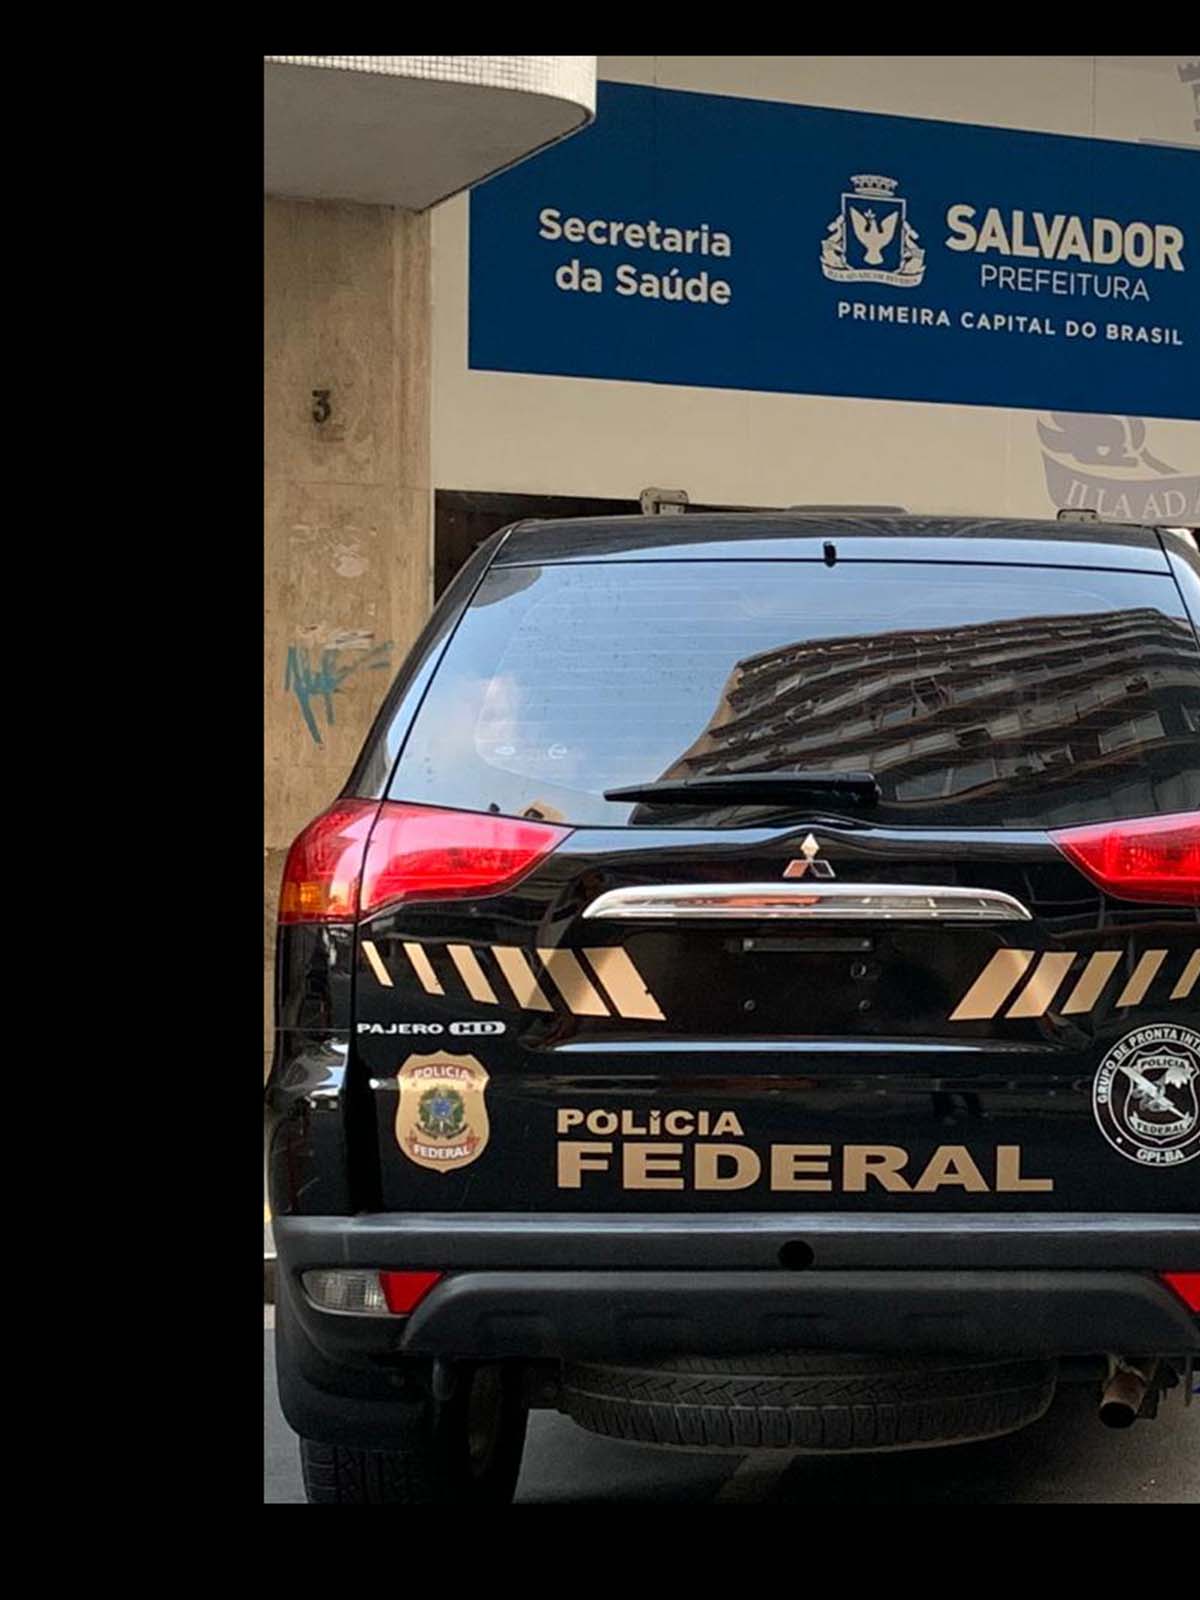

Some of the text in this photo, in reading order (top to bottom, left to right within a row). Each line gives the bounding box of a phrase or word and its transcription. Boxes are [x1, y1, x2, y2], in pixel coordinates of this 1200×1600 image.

[539, 208, 731, 257] Secretaria
[945, 204, 1185, 272] SALVADOR
[555, 249, 731, 304] da Saúde
[981, 264, 1151, 302] PREFEITURA
[838, 302, 1183, 345] PRIMEIRA CAPITAL DO BRASIL
[311, 389, 332, 423] 3
[1142, 489, 1187, 518] AD
[356, 1022, 503, 1035] PAJERO HD
[1097, 1059, 1117, 1104] GRUPO
[1113, 1042, 1130, 1059] DE
[1129, 1028, 1178, 1046] PRONTA
[1137, 1122, 1186, 1135] FEDERAL
[413, 1144, 471, 1159] FEDERAL
[557, 1141, 1054, 1192] FEDERAL
